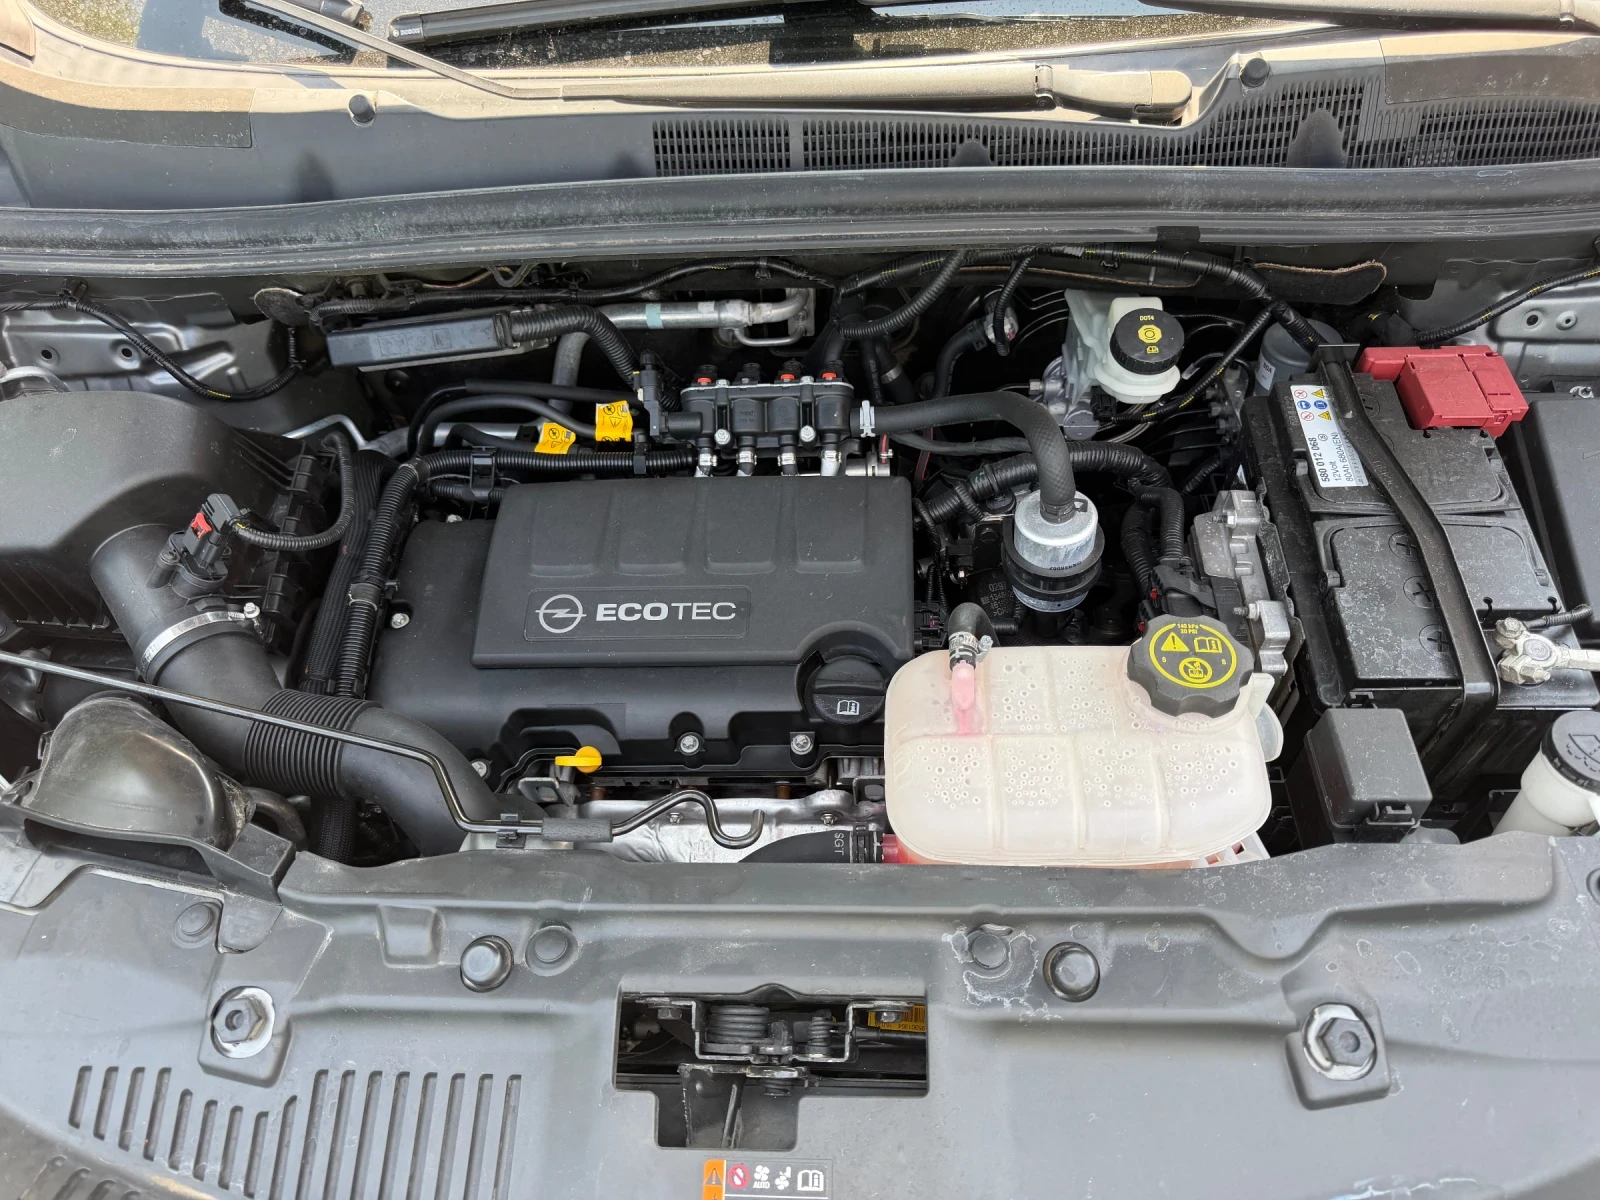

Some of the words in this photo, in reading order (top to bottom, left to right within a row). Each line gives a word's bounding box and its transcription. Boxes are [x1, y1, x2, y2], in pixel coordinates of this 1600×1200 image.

[1313, 452, 1325, 466] 012
[1318, 468, 1330, 482] 580
[1342, 464, 1354, 482] 80Ah
[596, 602, 736, 621] ECOTEC
[834, 832, 845, 856] SGT
[753, 1181, 770, 1189] AUTO
